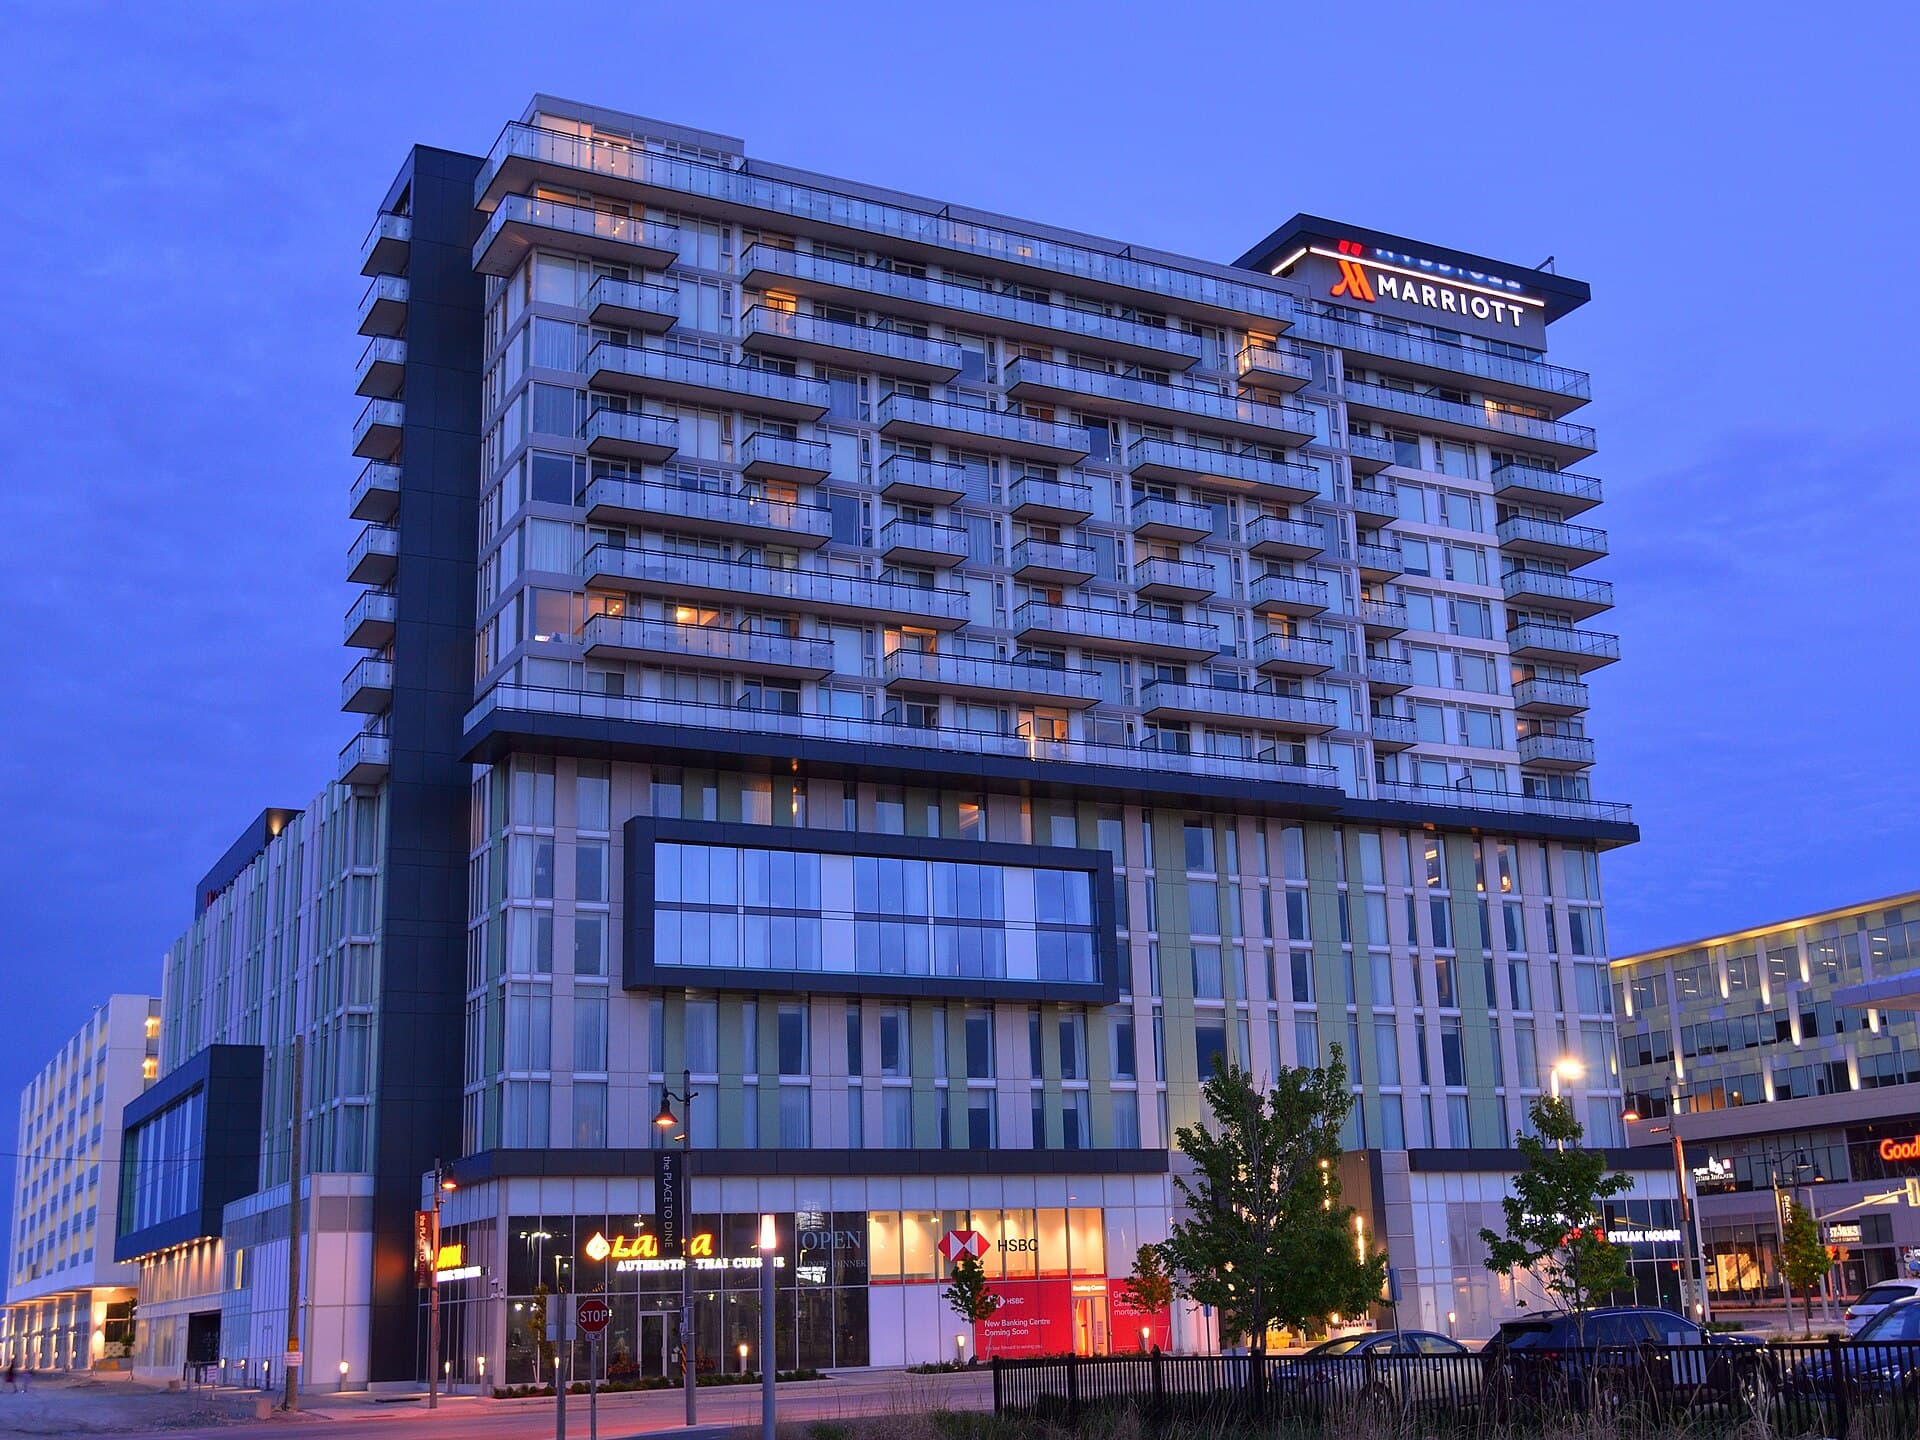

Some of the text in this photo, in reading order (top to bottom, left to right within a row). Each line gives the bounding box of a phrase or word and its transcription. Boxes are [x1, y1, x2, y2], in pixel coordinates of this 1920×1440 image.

[1377, 274, 1524, 327] MARRIOTT
[1880, 1135, 1920, 1160] Good
[663, 1156, 674, 1248] the PLACE TO DINE
[801, 1231, 862, 1250] OPEN
[1608, 1231, 1644, 1244] STEAK
[1645, 1229, 1681, 1243] HOUSE
[997, 1239, 1039, 1252] HSBC
[419, 1250, 426, 1262] TO
[616, 1257, 785, 1272] AUTHENTI THAI CUISE
[1006, 1297, 1025, 1305] HSBC
[580, 1310, 609, 1323] STOP
[1001, 1319, 1028, 1328] Banking
[1029, 1318, 1051, 1326] Centre
[984, 1328, 1029, 1337] Coming Soon
